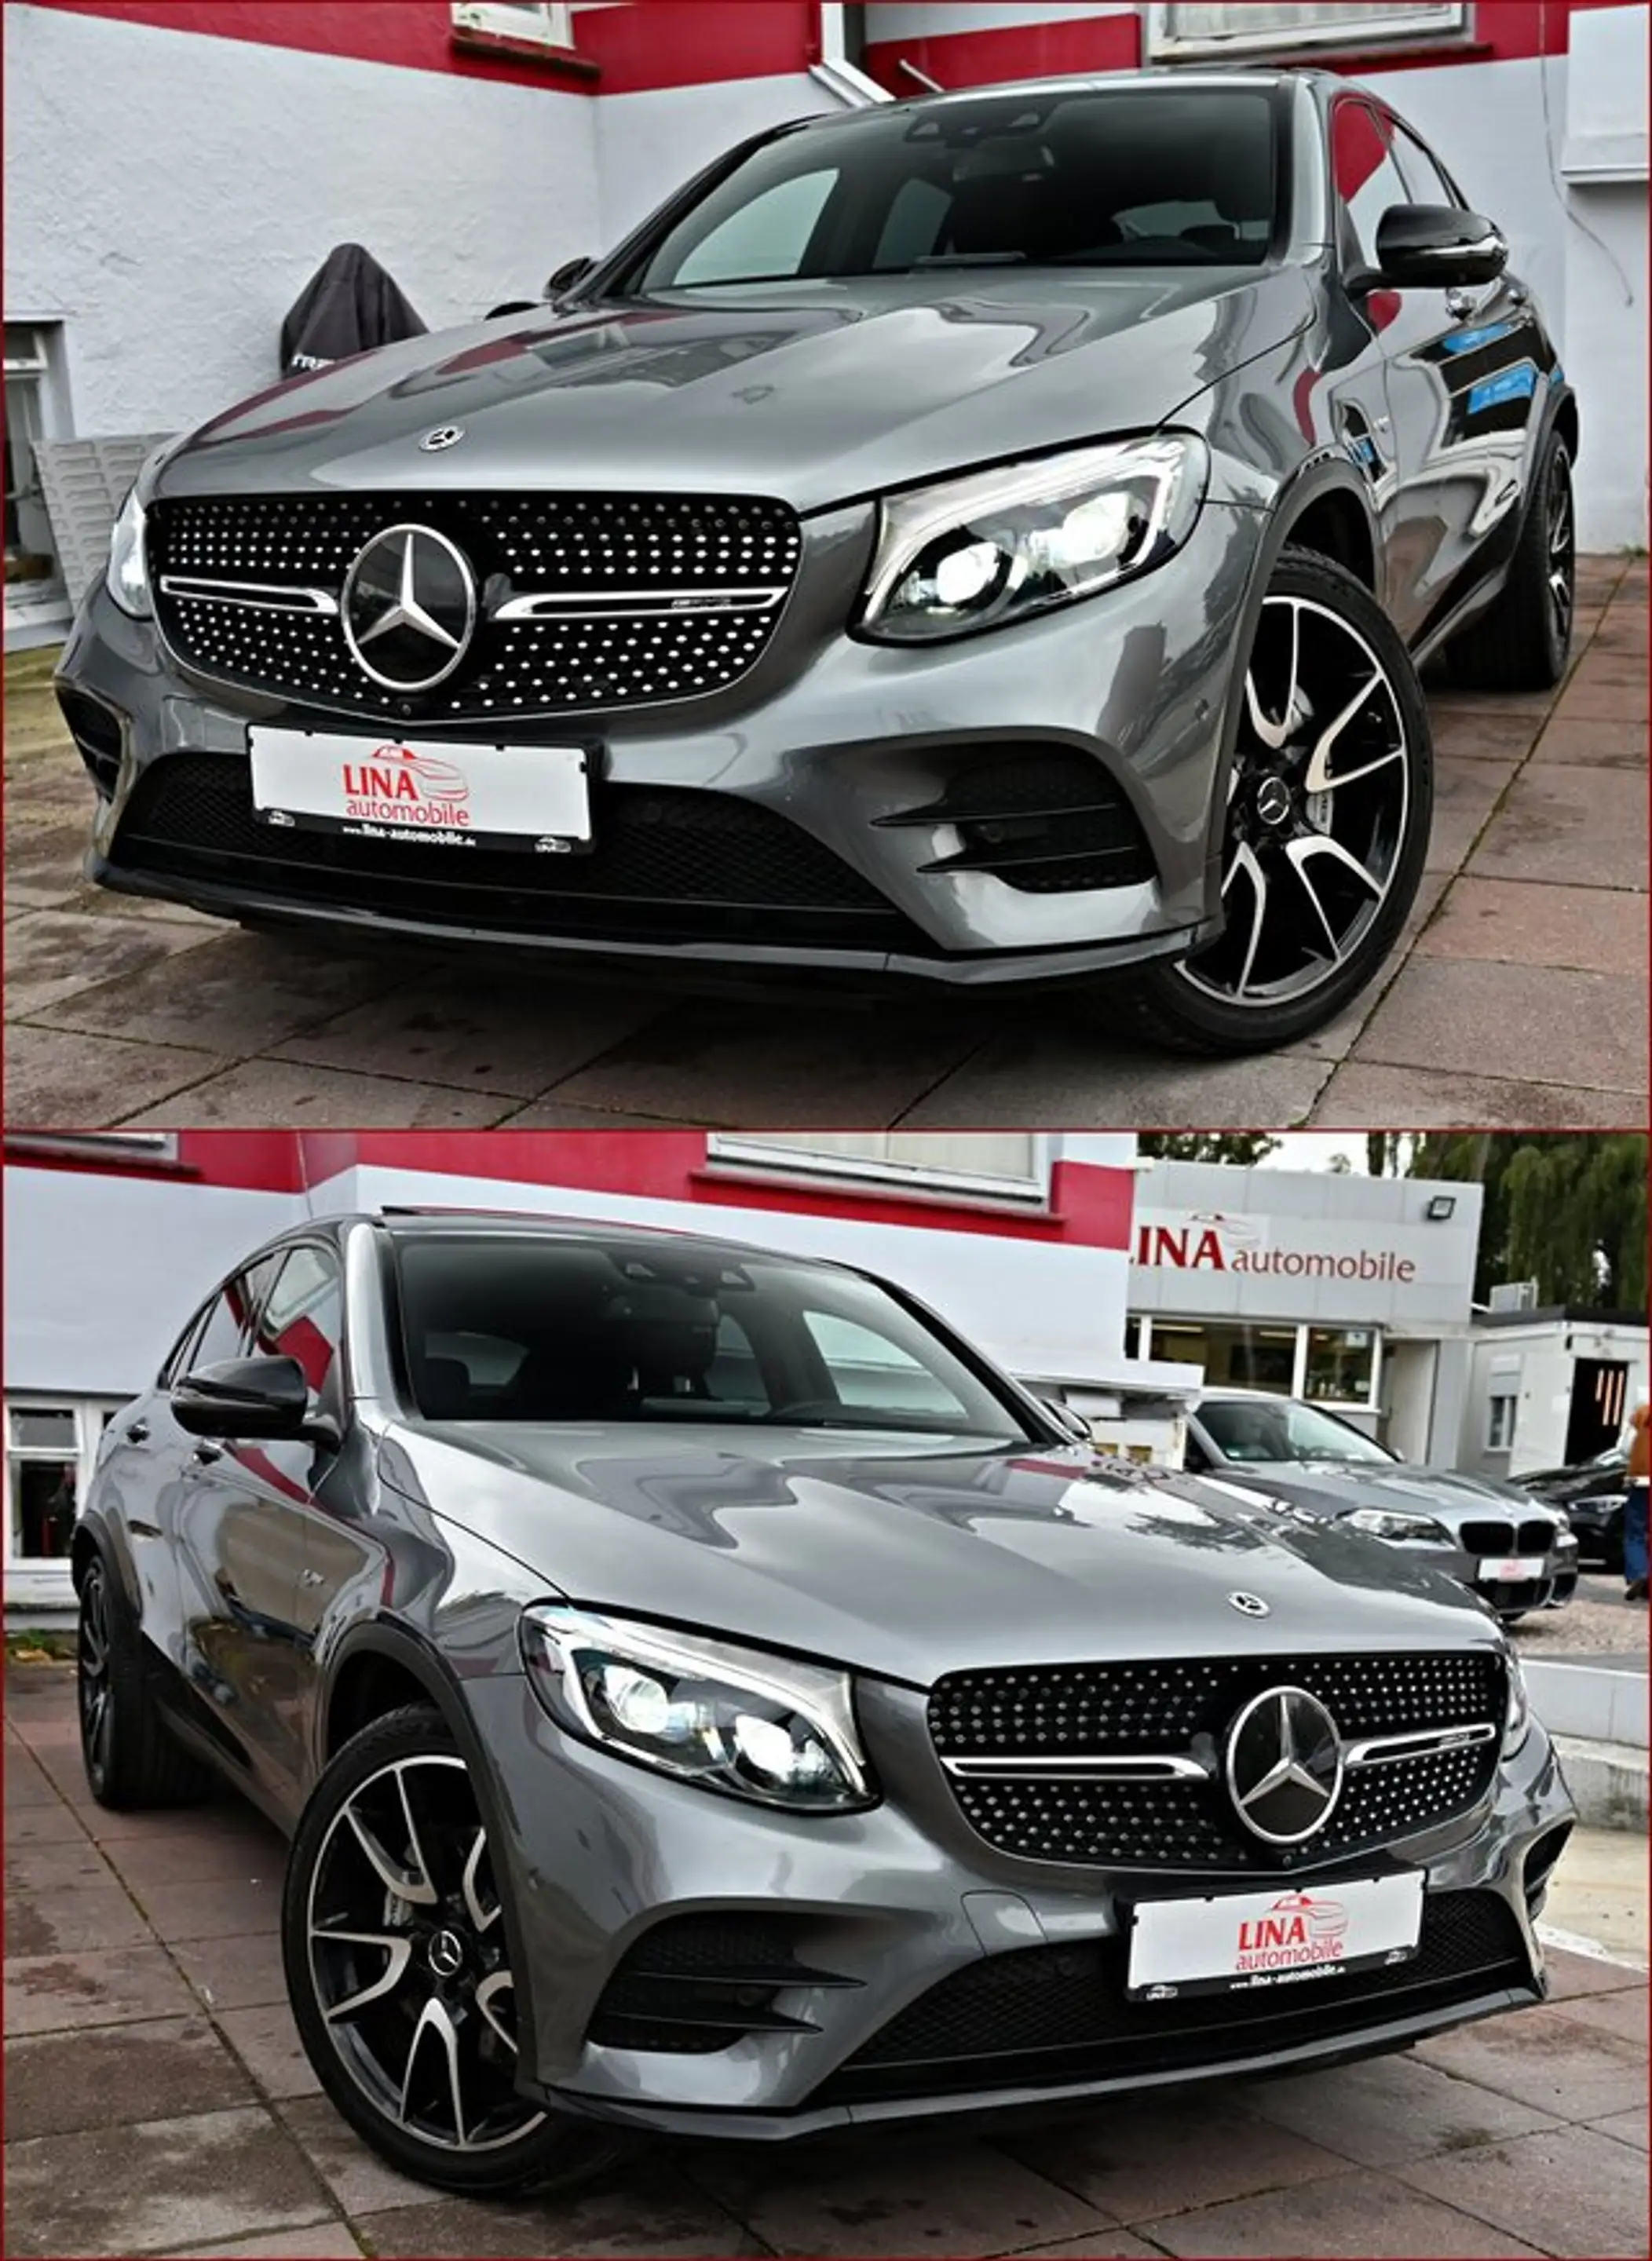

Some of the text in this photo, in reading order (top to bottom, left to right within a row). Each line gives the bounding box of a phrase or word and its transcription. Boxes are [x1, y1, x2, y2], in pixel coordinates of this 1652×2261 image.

[342, 764, 419, 802] LINA
[346, 799, 470, 827] automobile
[1129, 1225, 1416, 1283] INA automobile
[1238, 1916, 1306, 1951] LINA
[1235, 1937, 1343, 1971] automobile
